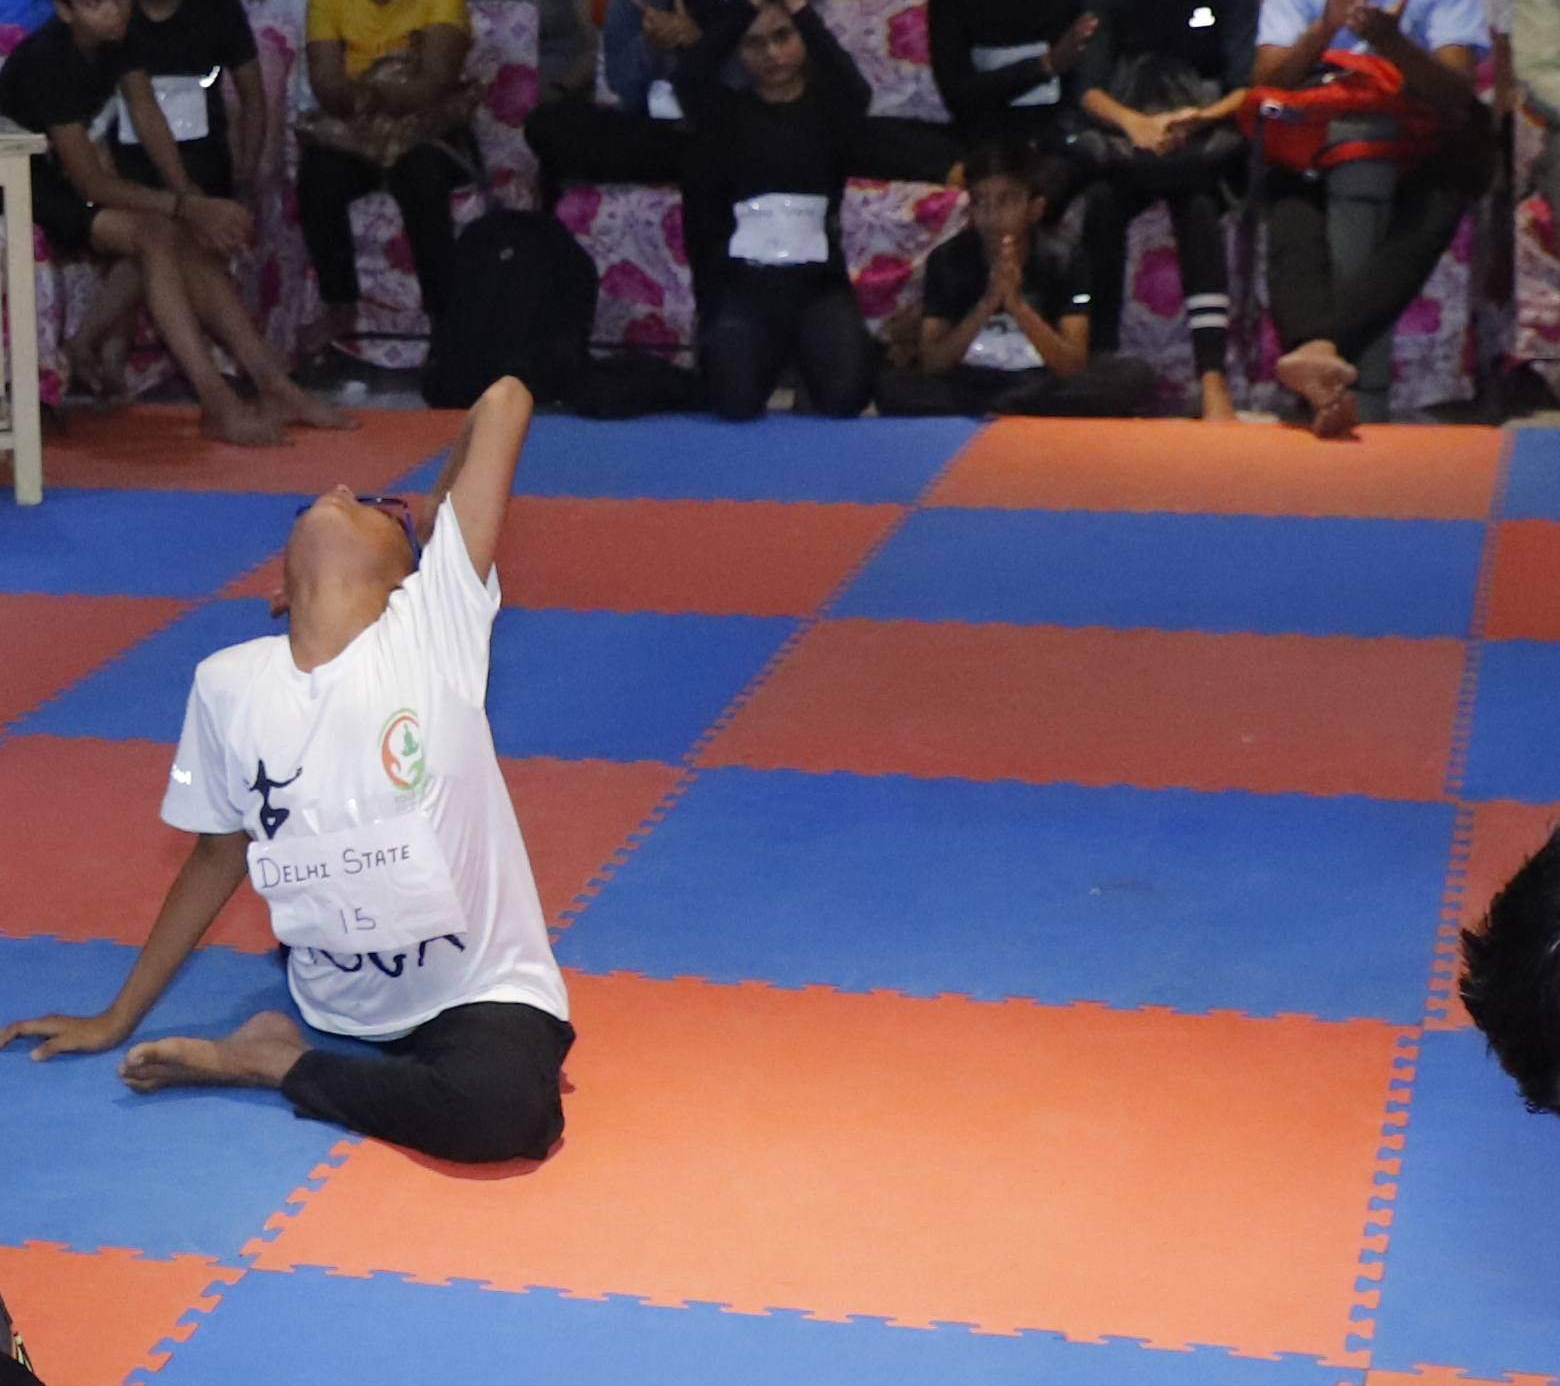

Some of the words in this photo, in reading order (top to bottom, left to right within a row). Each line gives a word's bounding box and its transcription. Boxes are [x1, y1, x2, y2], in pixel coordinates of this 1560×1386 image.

[256, 857, 331, 889] DELHI
[343, 844, 410, 875] STATE
[339, 907, 376, 934] 15
